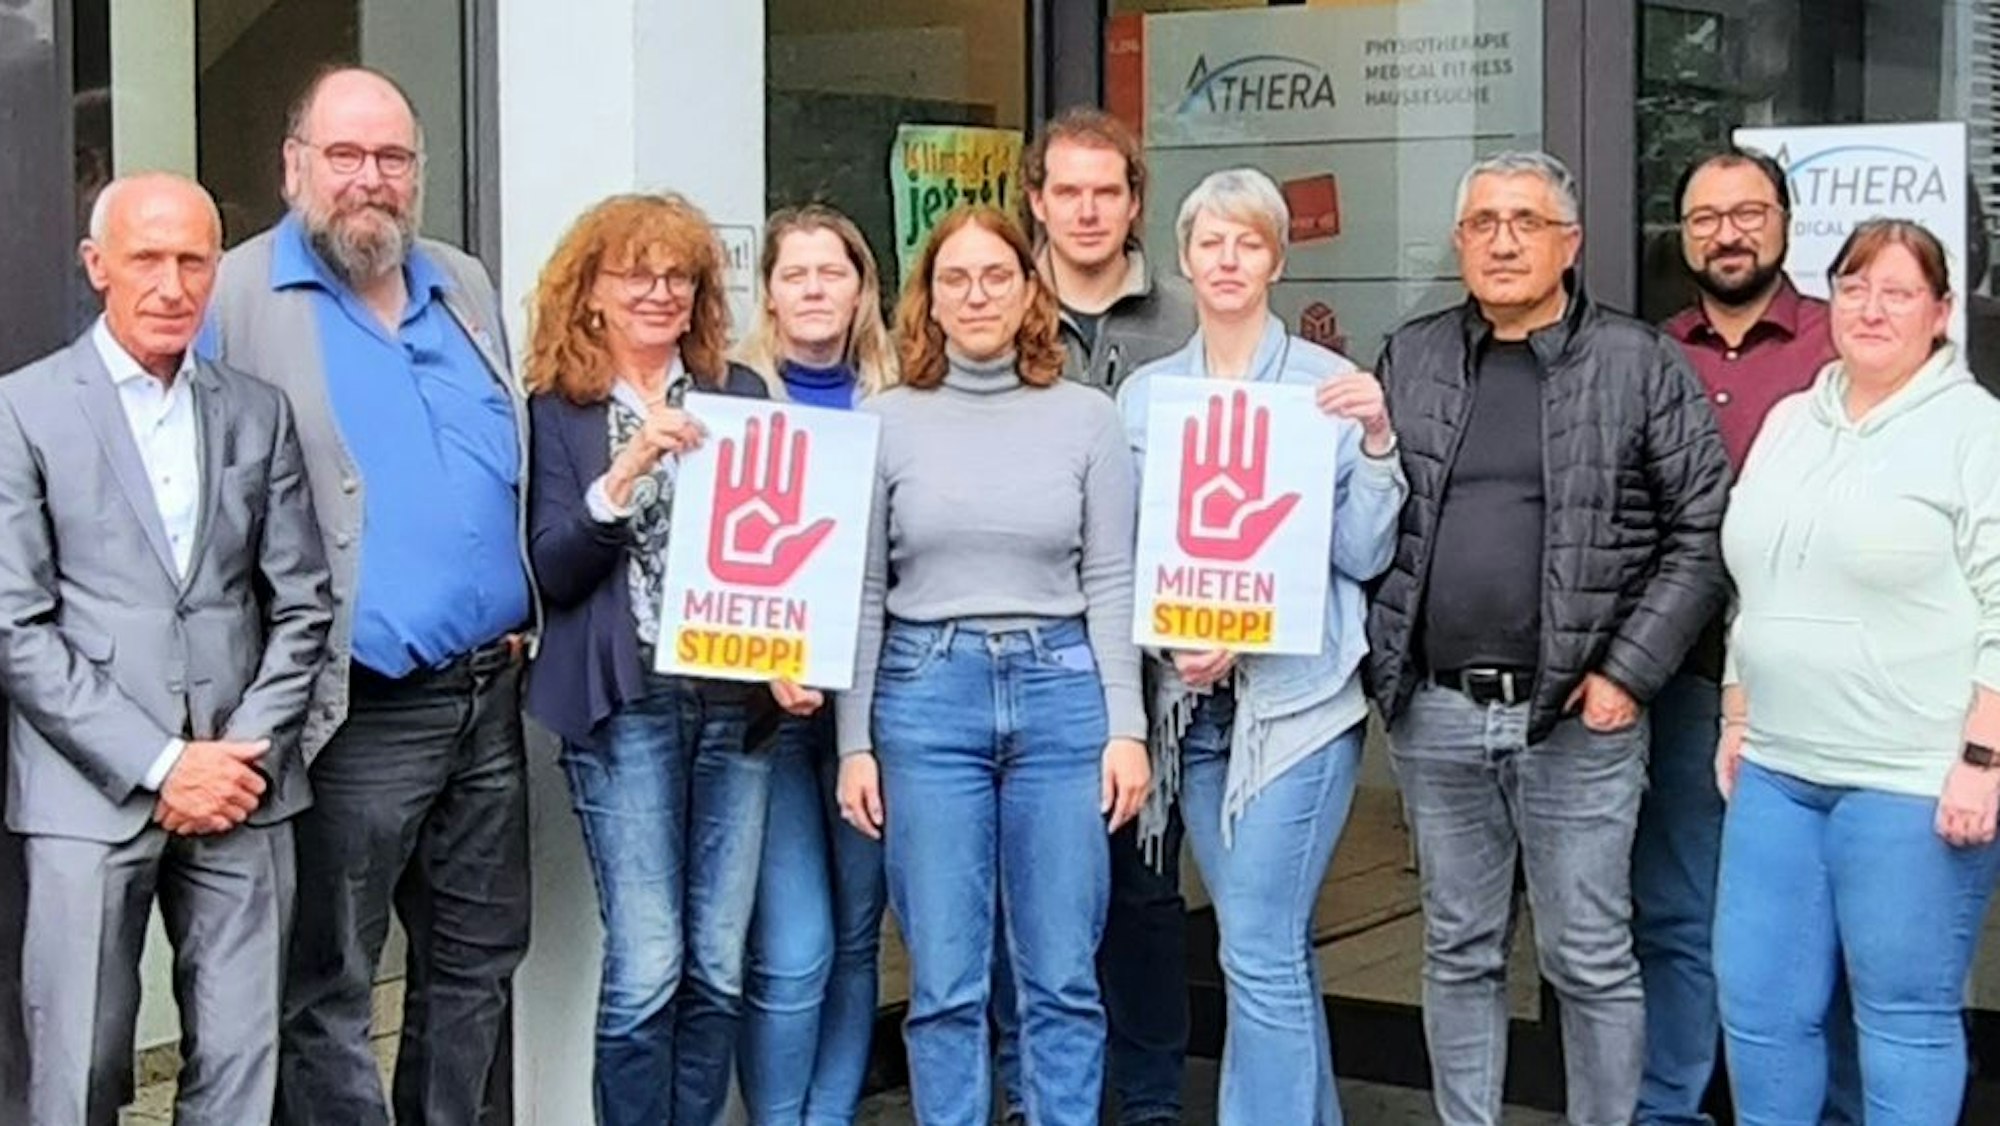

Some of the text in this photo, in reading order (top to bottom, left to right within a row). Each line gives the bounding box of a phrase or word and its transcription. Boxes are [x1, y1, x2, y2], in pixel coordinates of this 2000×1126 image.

[1178, 53, 1336, 113] ATHERA
[1365, 58, 1514, 81] MEDICAL FITNESS
[905, 155, 1008, 247] jetzt!
[1793, 219, 1845, 237] DICAL
[1156, 565, 1274, 603] MIETEN
[683, 589, 808, 632] MIETEN
[1154, 602, 1274, 643] STOPP!
[677, 629, 804, 673] STOPP!
